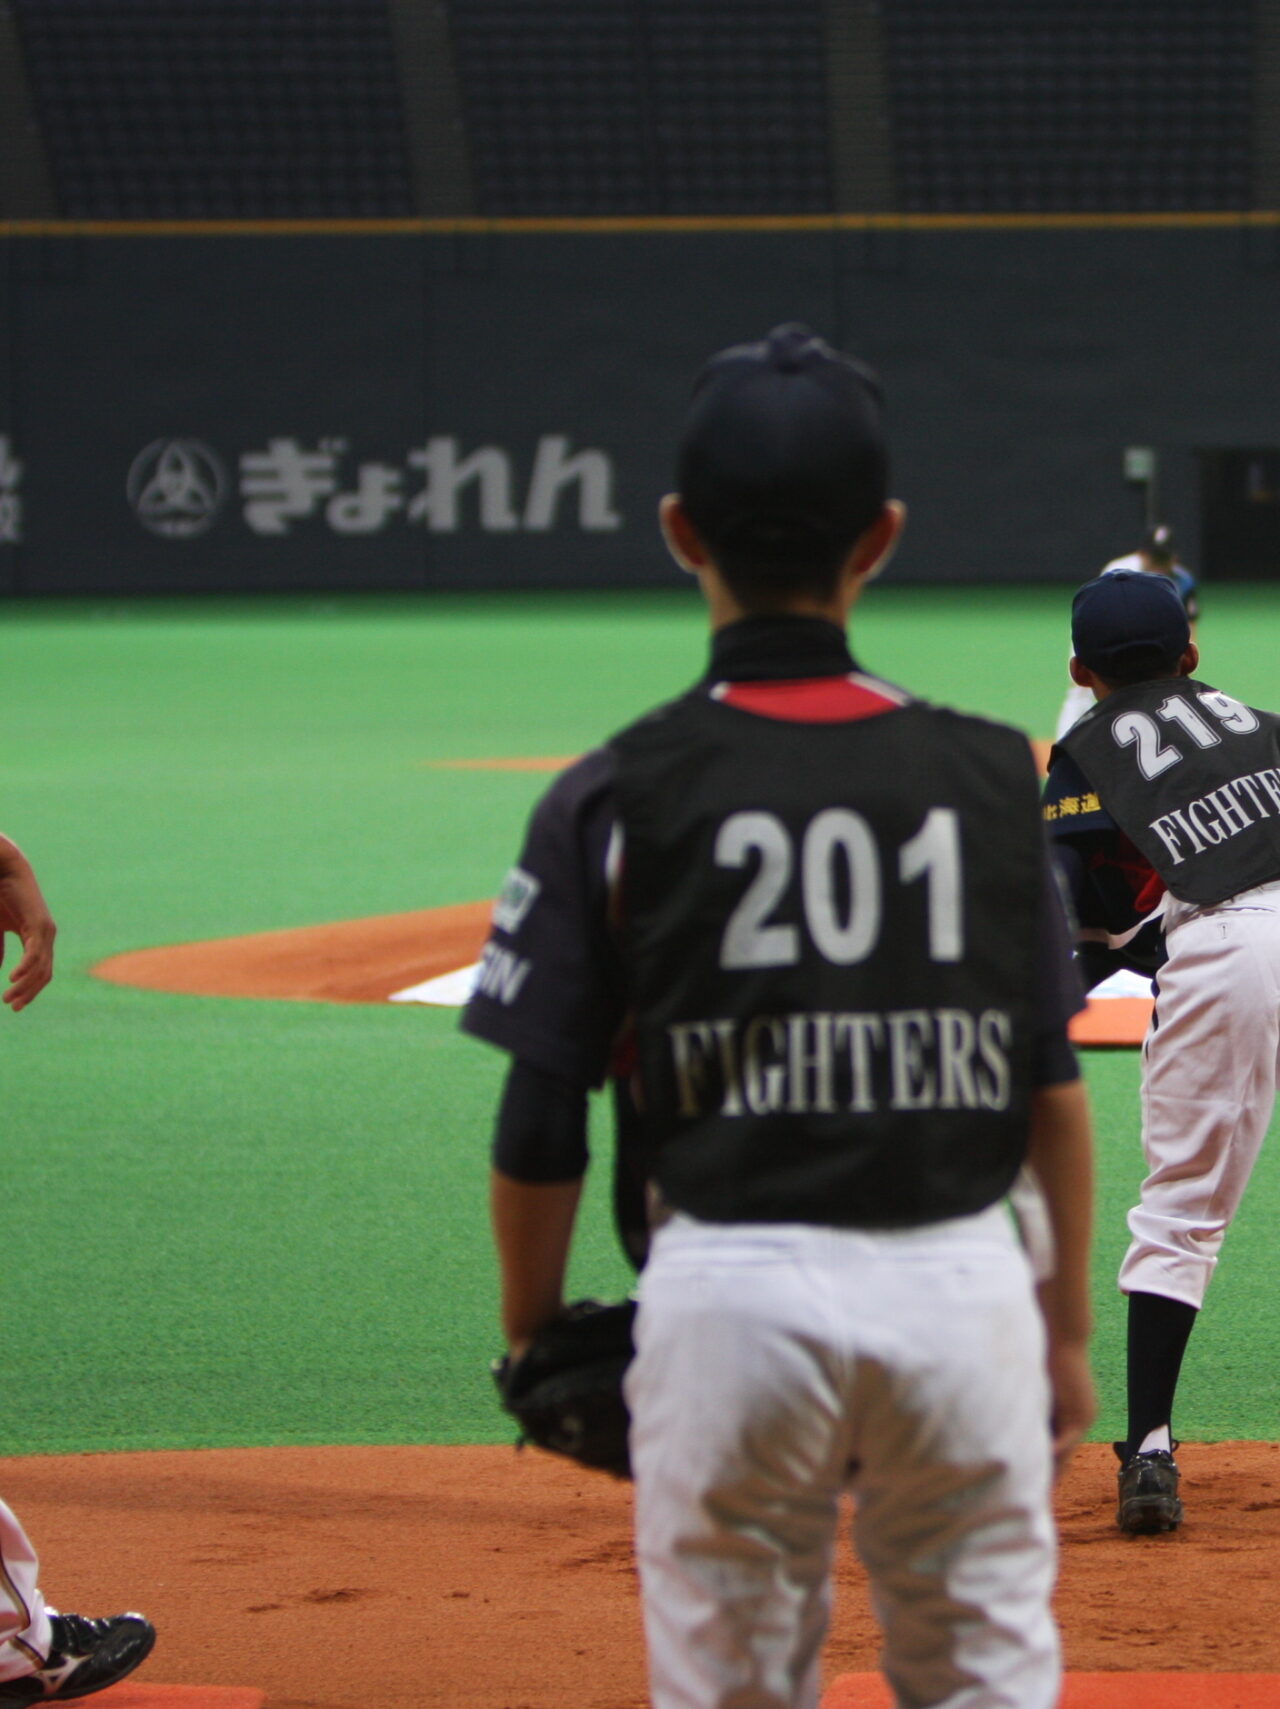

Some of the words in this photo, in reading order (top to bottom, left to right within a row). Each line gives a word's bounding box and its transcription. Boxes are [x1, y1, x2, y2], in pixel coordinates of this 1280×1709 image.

[239, 435, 622, 535] ぎょれん
[1111, 691, 1260, 781] 219
[713, 806, 965, 971] 201
[667, 1007, 1014, 1118] FIGHTERS
